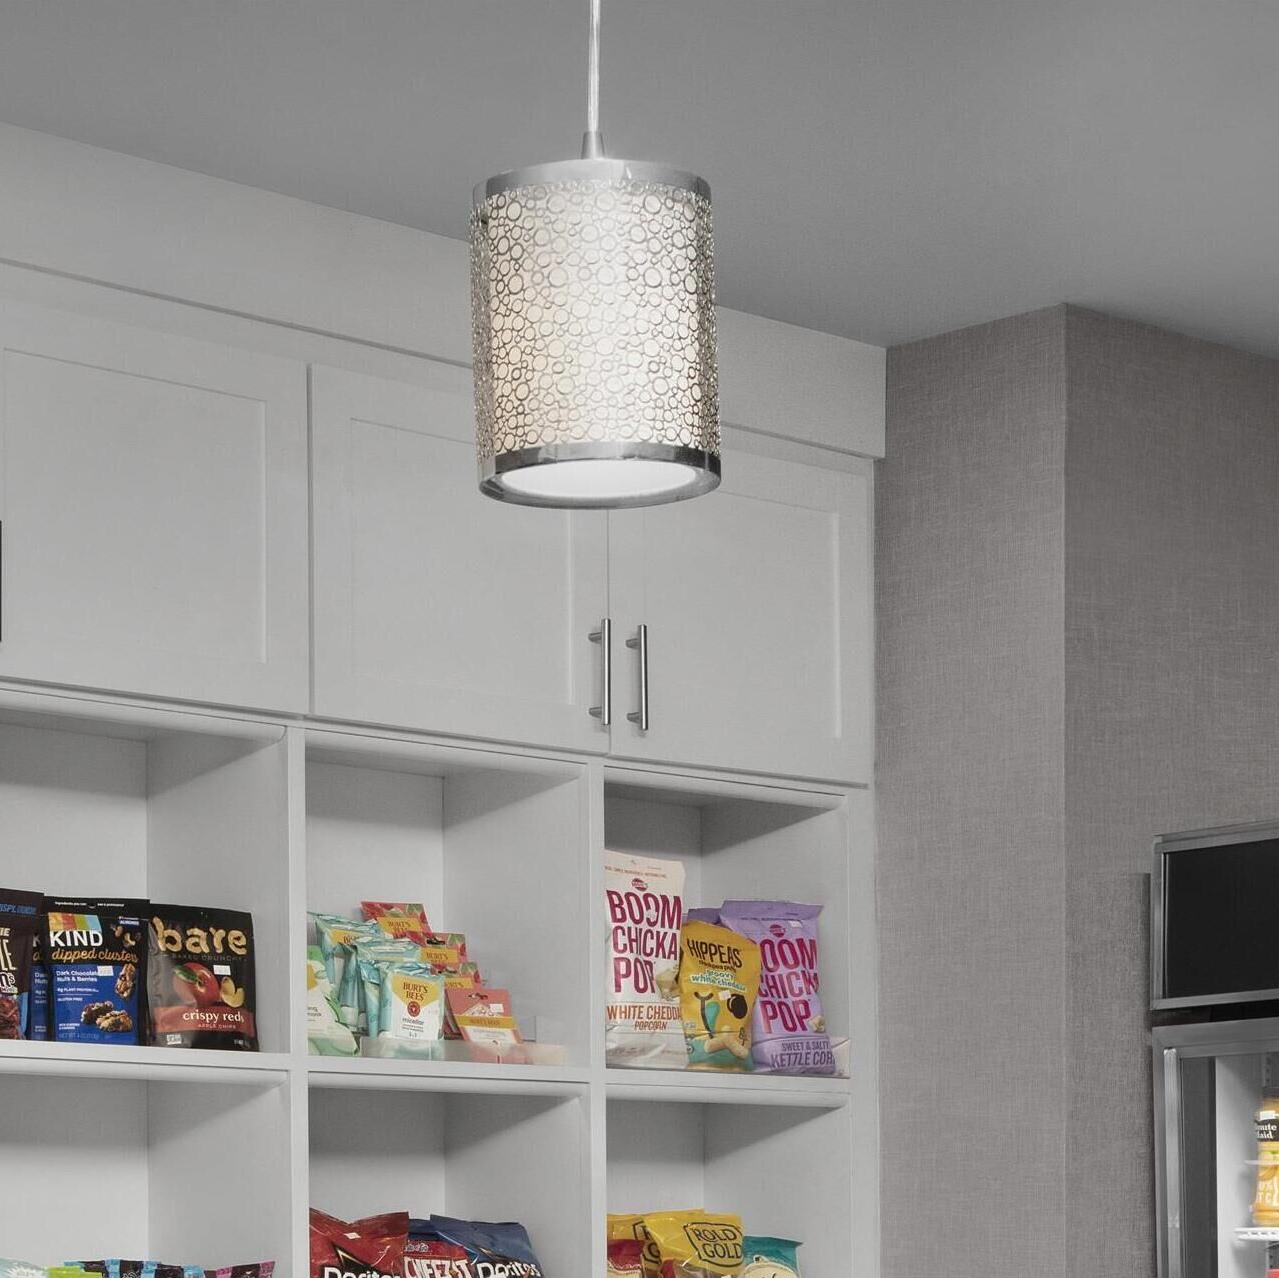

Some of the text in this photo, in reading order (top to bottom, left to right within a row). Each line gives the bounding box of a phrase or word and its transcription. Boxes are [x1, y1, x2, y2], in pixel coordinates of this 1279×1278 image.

[606, 890, 682, 930] BOOM
[49, 930, 103, 947] KIND
[152, 916, 247, 955] bare
[612, 926, 678, 960] CHICKA
[52, 948, 97, 963] dipped
[687, 938, 742, 968] HIPPEAS
[755, 938, 818, 973] OOM
[406, 991, 425, 1001] BEES
[183, 1009, 219, 1022] crispy
[607, 1004, 643, 1020] WHITE
[761, 1000, 812, 1034] POP
[634, 1021, 667, 1031] POPCORN
[772, 1053, 811, 1068] KETTLE
[692, 1227, 737, 1242] ROLD
[701, 1243, 743, 1259] GOLD
